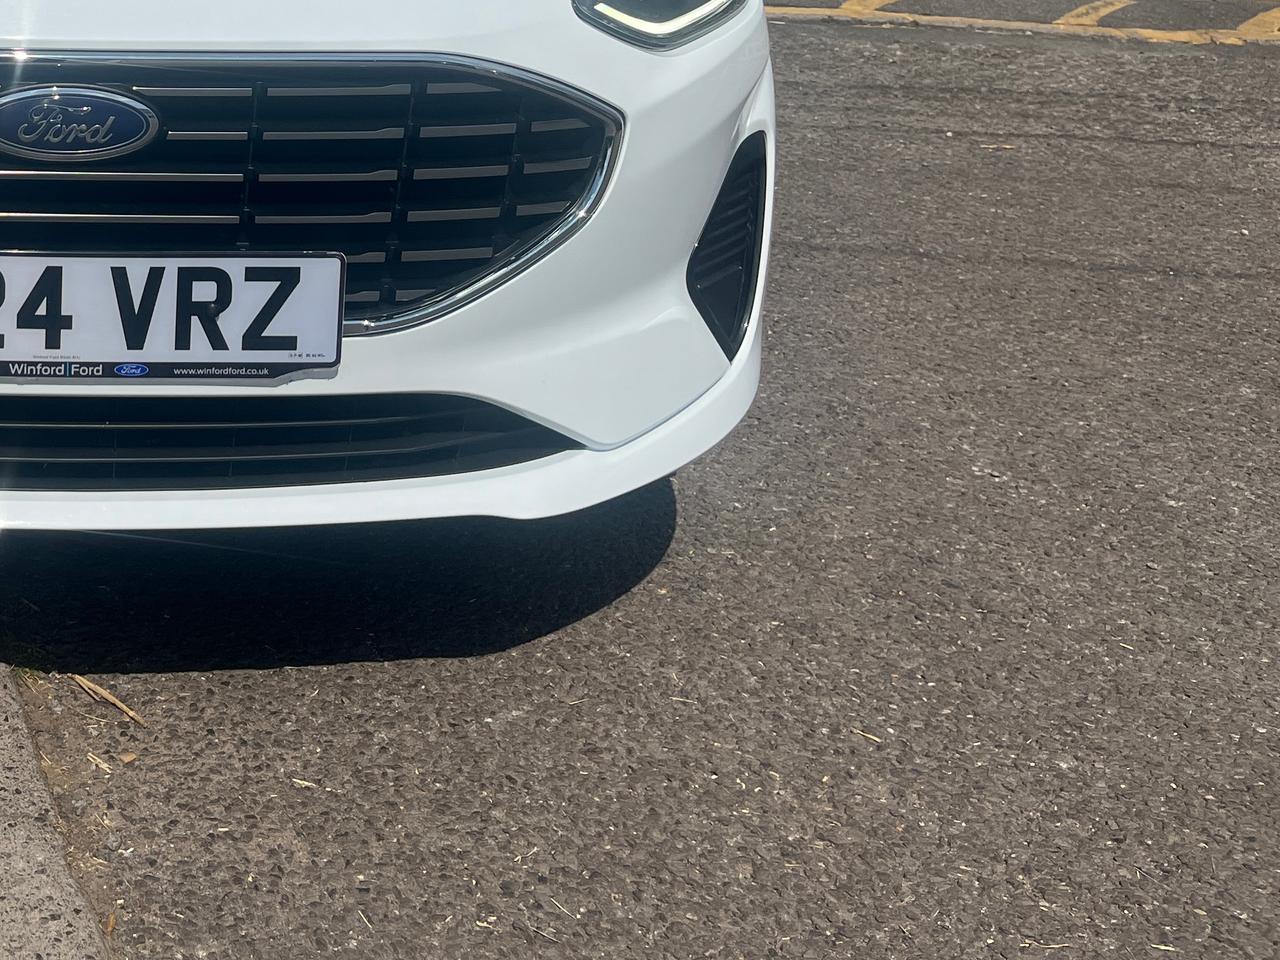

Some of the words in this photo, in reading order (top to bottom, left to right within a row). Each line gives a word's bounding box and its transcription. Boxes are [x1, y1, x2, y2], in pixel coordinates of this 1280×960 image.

[18, 103, 116, 145] Ford
[110, 266, 302, 352] VRZ
[9, 363, 65, 376] Winford
[71, 364, 103, 376] Ford
[173, 367, 270, 376] www.winfordford.co.uk
